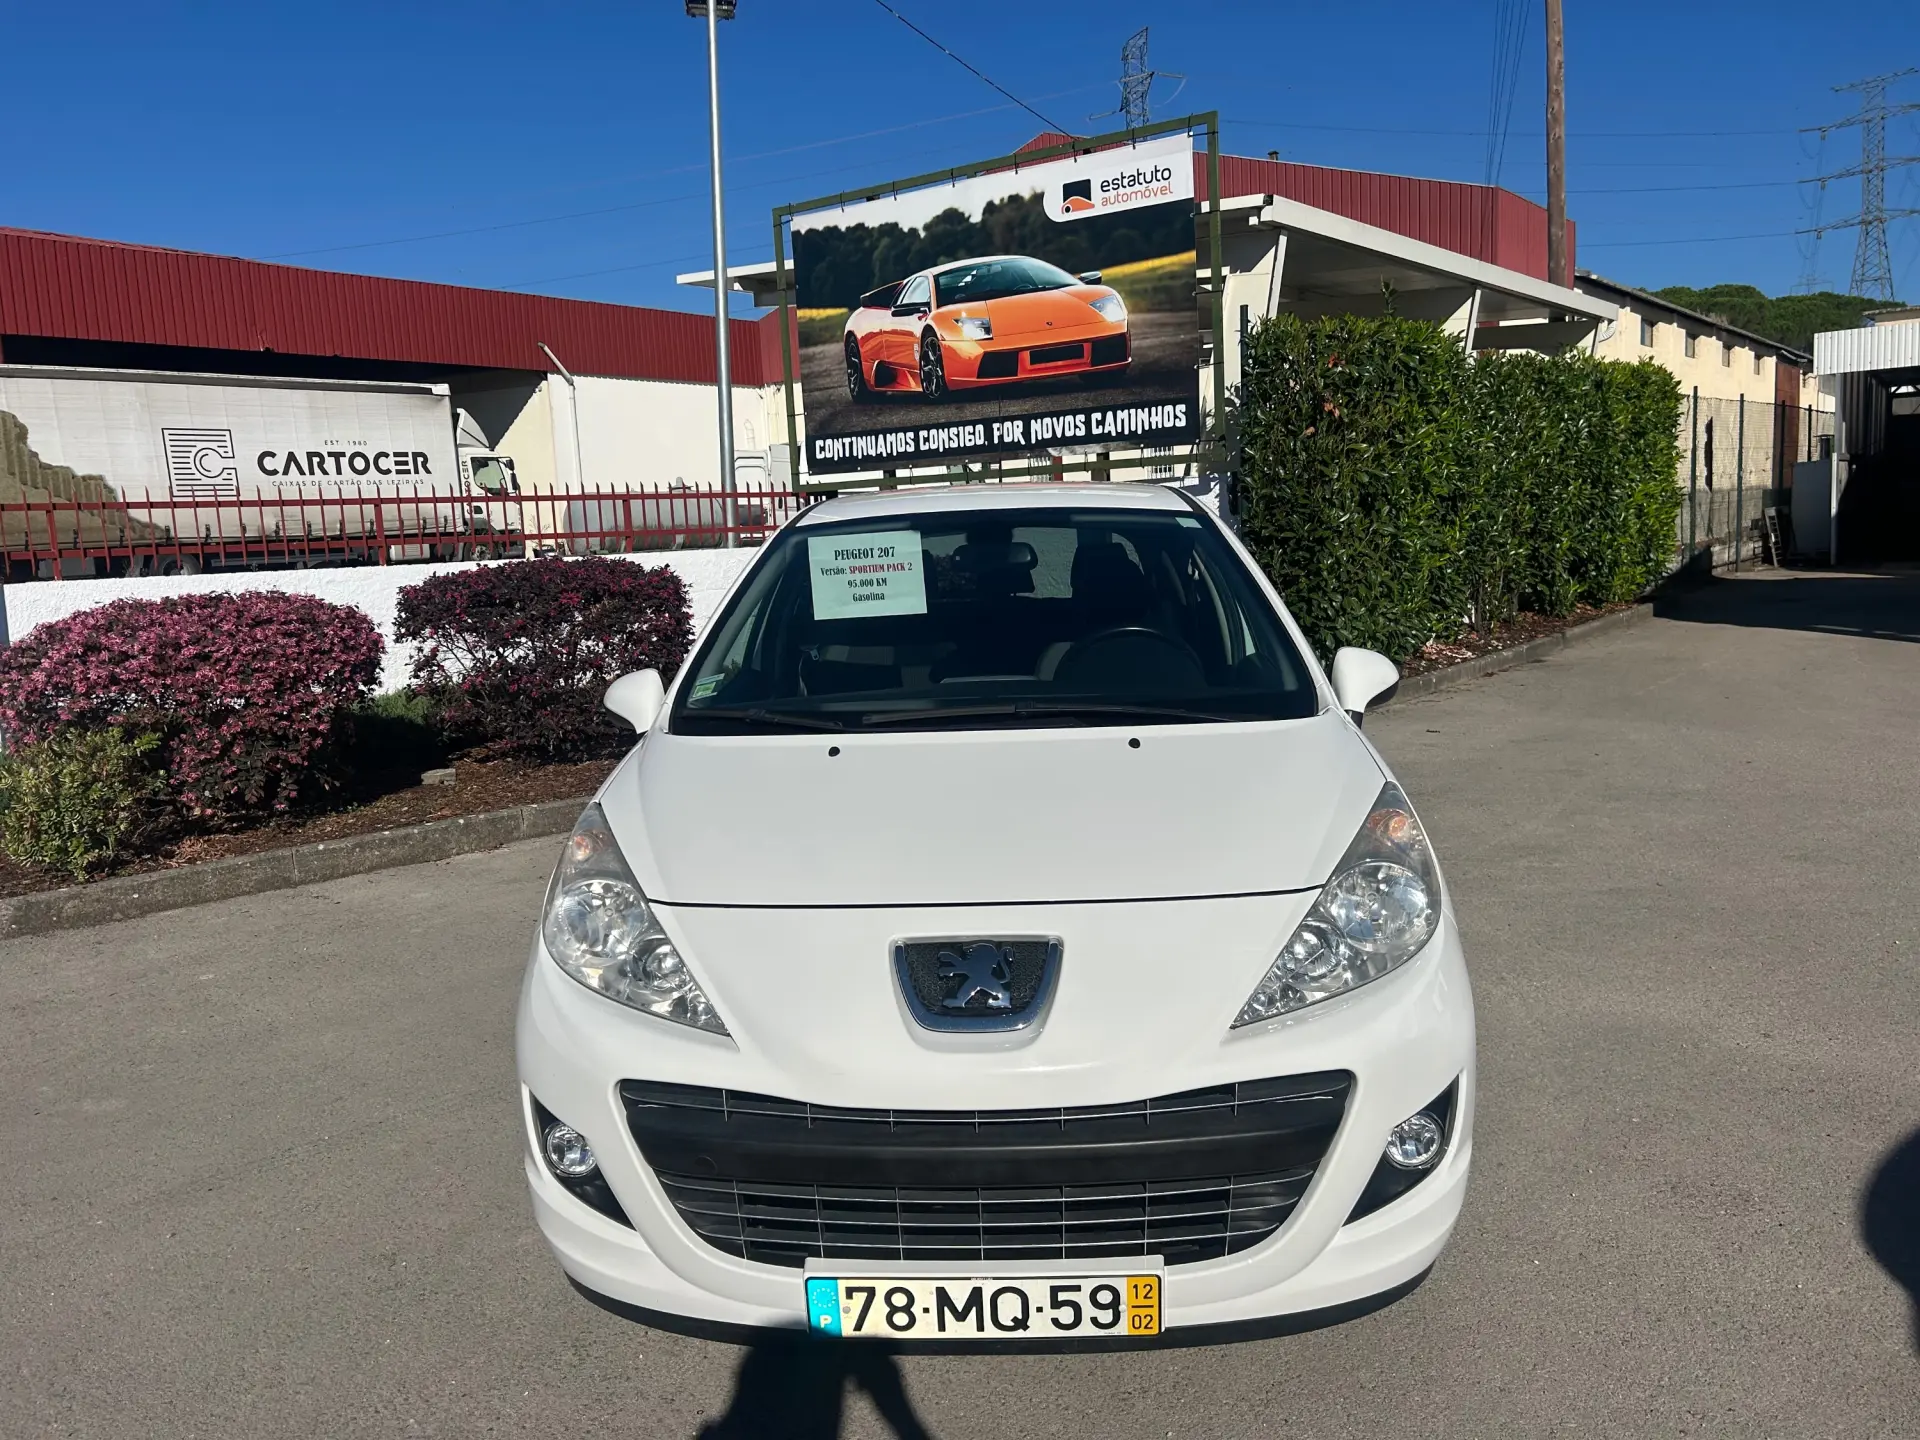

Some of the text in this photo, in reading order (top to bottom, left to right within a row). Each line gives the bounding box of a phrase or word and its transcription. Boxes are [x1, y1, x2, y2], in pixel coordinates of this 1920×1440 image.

[1100, 164, 1172, 193] estatuto
[1101, 180, 1173, 207] automóvel
[815, 431, 915, 461] CONTINUAMOS
[992, 419, 1026, 445] POR
[1030, 413, 1086, 442] NOVOS
[1091, 403, 1187, 436] CAMINHOS
[256, 450, 433, 477] CARTOCER
[327, 478, 361, 486] CARTÃO
[834, 546, 896, 561] PEUGEOT 207
[820, 562, 913, 577] Versão: SPORTIUM PACK 2
[847, 577, 888, 589] 95.000 KM
[852, 592, 886, 603] Gasolina
[1132, 1283, 1154, 1300] 12
[819, 1315, 833, 1329] P
[1131, 1313, 1154, 1330] 02
